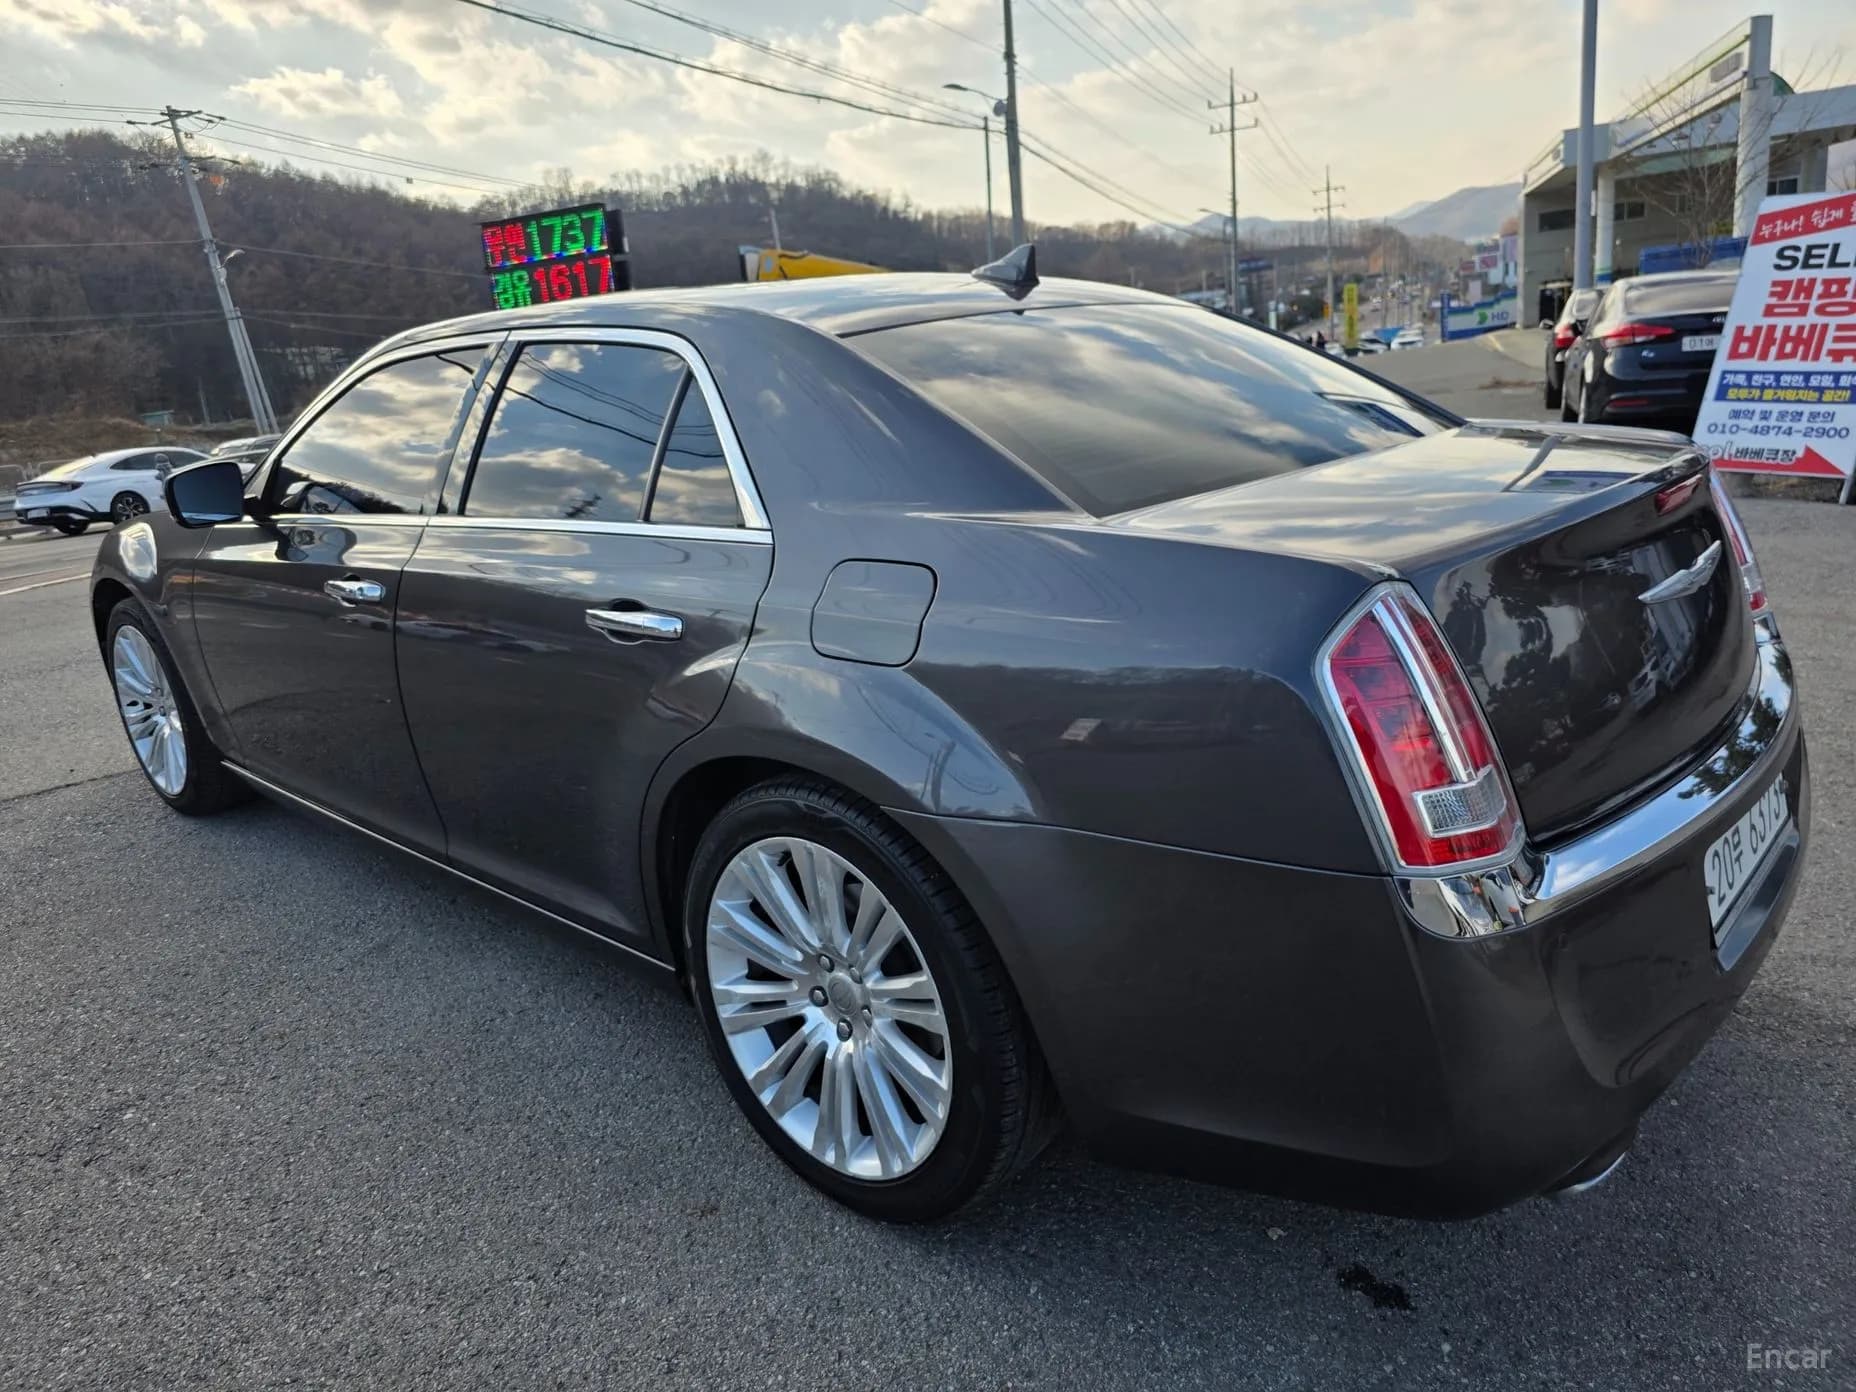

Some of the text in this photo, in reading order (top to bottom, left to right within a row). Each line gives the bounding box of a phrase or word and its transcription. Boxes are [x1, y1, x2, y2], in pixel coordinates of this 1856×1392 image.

[527, 209, 604, 260] 1737
[1759, 215, 1804, 238] 누구나!
[1811, 207, 1844, 228] 쉽게
[1773, 242, 1856, 271] SEL
[494, 256, 610, 309] 경유 1617
[1763, 277, 1856, 317] 캠핑
[1727, 323, 1856, 363] 바베큐
[1707, 423, 1850, 439] 010-4874-2900
[1728, 409, 1836, 423] 예약 및 운영 문의
[1733, 447, 1796, 462] 바베큐장
[1712, 825, 1743, 907] 20무
